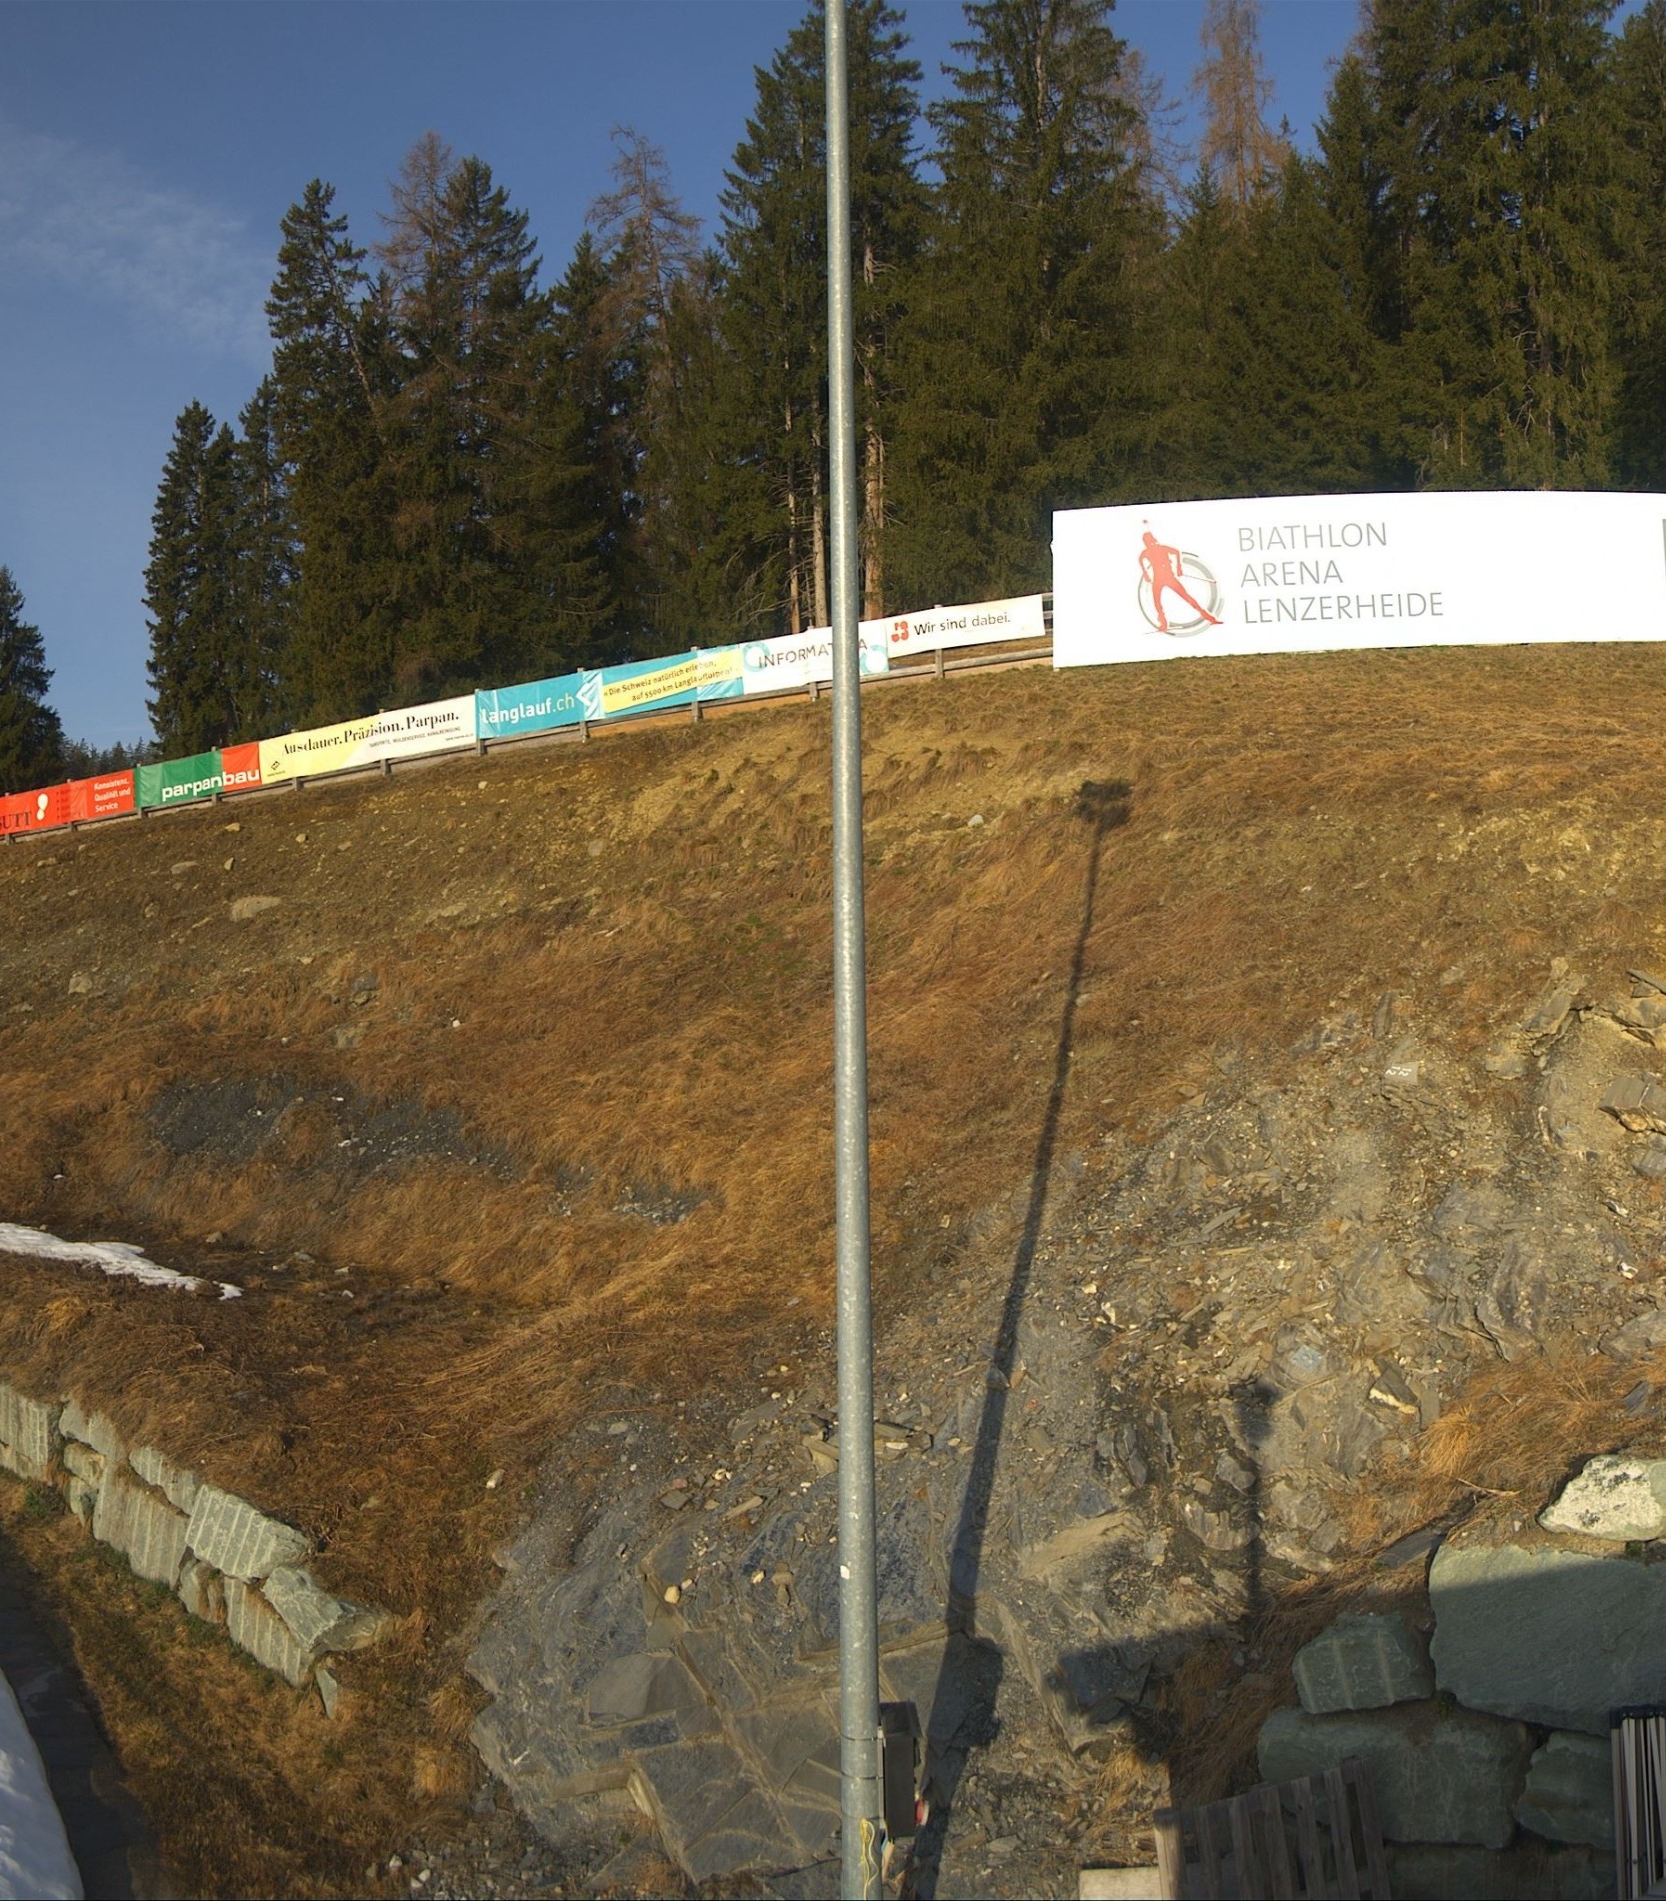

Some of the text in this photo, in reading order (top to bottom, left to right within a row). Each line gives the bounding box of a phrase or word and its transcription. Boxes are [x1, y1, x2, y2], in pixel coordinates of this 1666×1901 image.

[1238, 522, 1387, 552] BIATHLON
[1241, 560, 1343, 588] ARENA
[1244, 592, 1444, 624] LENZERHEIDE
[913, 611, 1011, 636] Wir sind dabei.
[621, 679, 652, 693] Schweiz
[653, 669, 684, 685] natürlich
[632, 692, 644, 701] auf
[645, 687, 662, 699] 5500
[662, 684, 674, 693] km
[479, 692, 575, 724] langlauf.ch
[283, 711, 459, 755] Ausdauer. Präzision. Parpan.
[120, 788, 131, 797] und
[162, 769, 260, 802] parpanbau
[95, 801, 119, 813] Service
